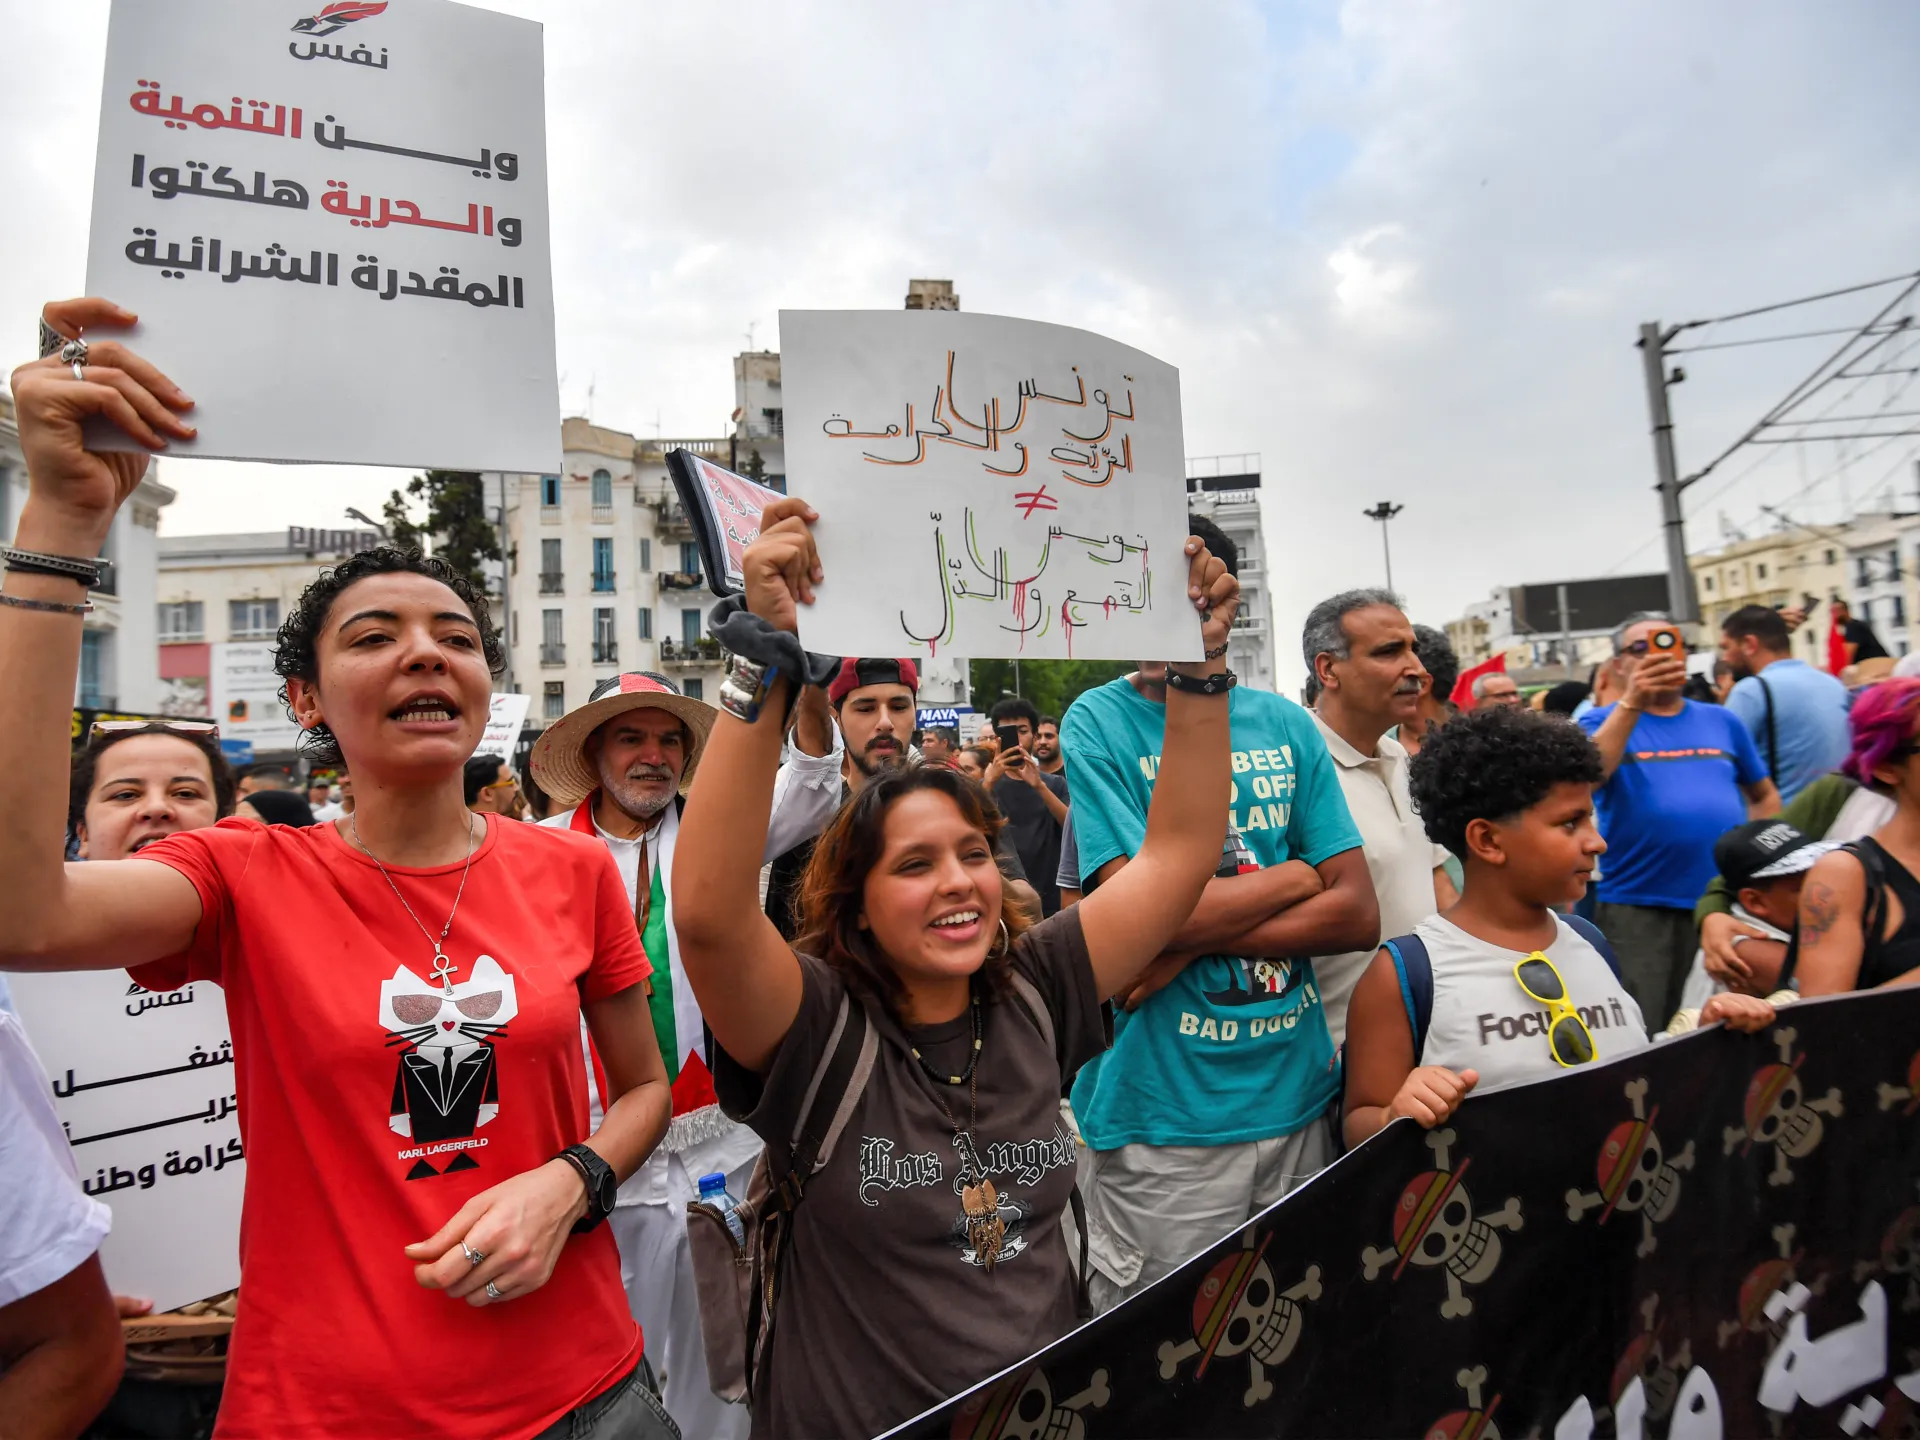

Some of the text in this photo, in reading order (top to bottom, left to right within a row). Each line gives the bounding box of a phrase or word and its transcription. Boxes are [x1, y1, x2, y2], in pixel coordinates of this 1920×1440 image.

[288, 40, 389, 70] نفس
[129, 79, 303, 139] التنمية
[130, 154, 523, 248] والحرية هلكتوا
[125, 227, 525, 309] المقدرة الشرائية
[918, 708, 959, 722] MAYA
[1179, 1011, 1239, 1041] BAD
[1477, 1009, 1554, 1046] Focu
[398, 1138, 489, 1160] KARL LAGERFELD
